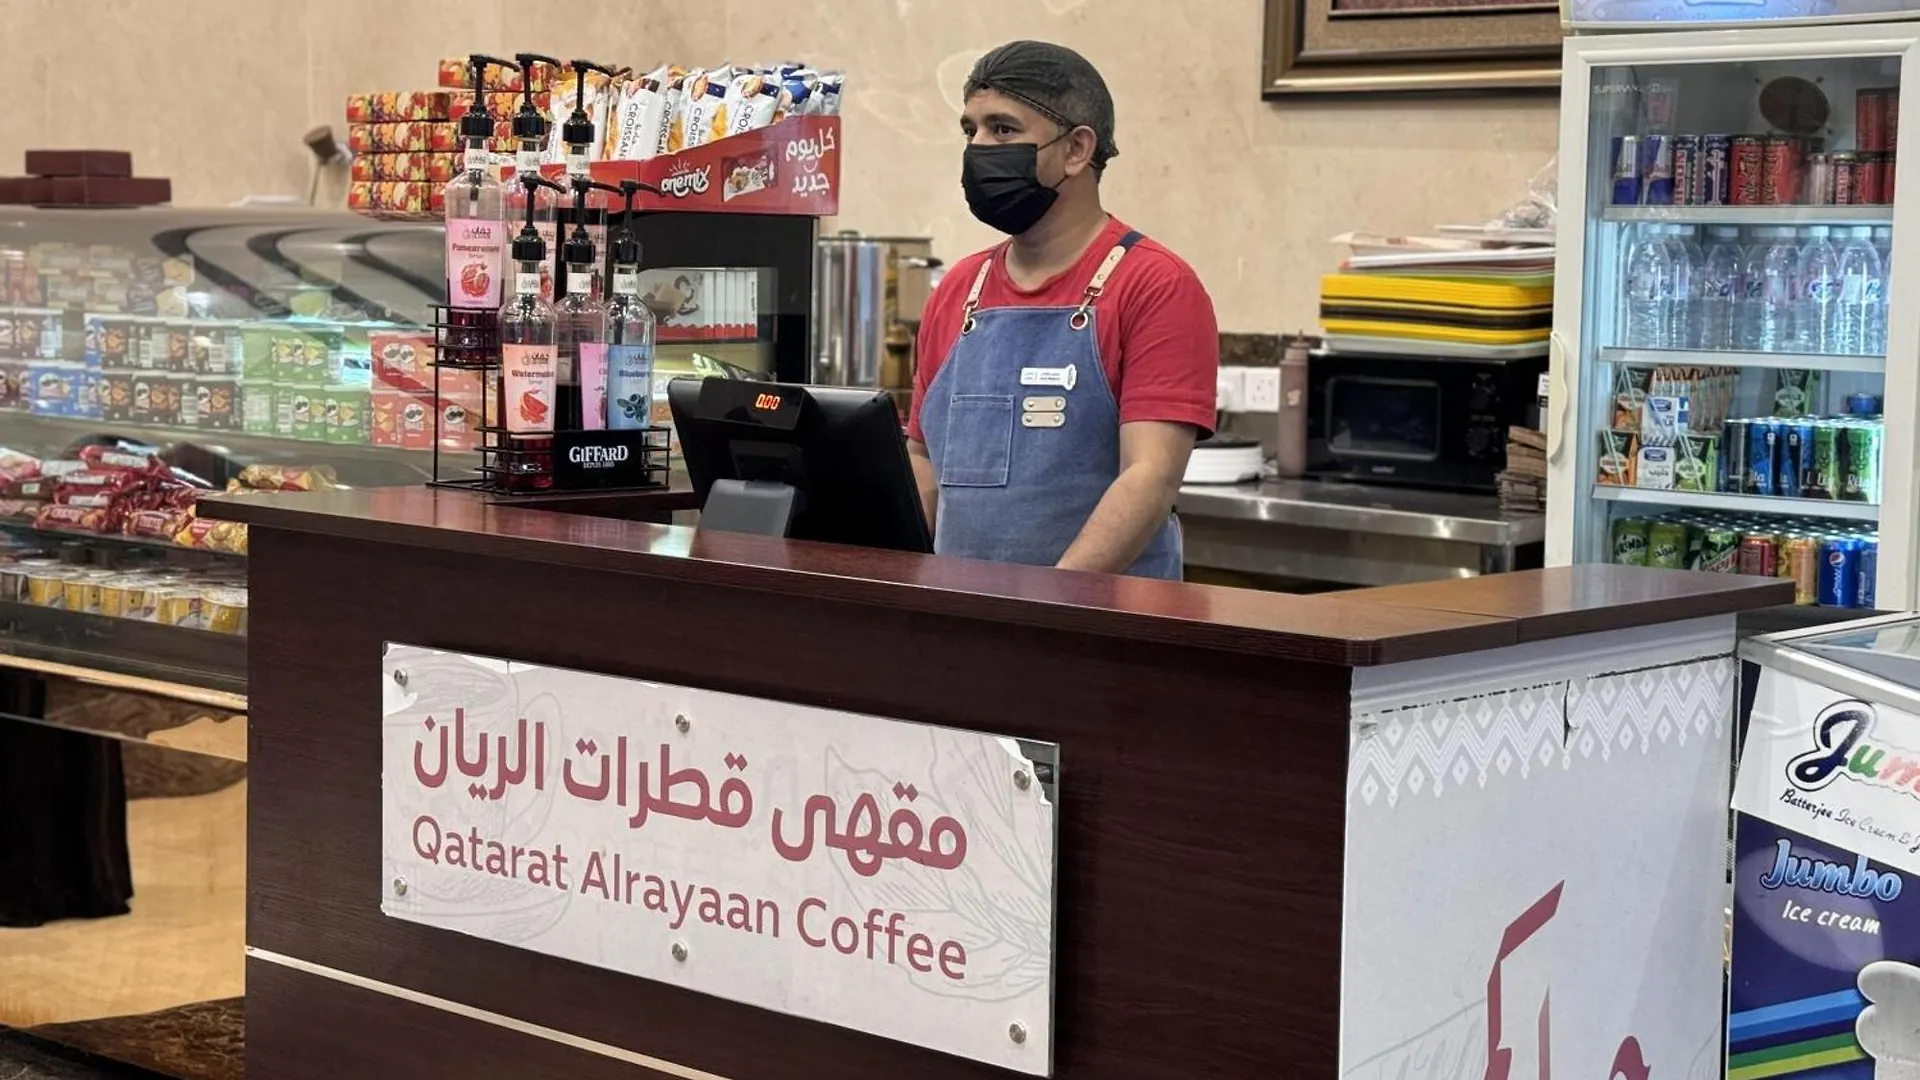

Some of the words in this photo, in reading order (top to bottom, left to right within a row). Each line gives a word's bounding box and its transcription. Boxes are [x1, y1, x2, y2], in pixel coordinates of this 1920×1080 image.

[791, 171, 831, 198] جديد
[569, 445, 629, 463] GIFFARD
[413, 707, 545, 800] الريان
[563, 736, 753, 829] قطرات
[771, 780, 967, 878] مقهى
[1780, 787, 1833, 820] Batterjee
[1834, 808, 1857, 828] Ice
[412, 815, 568, 890] Qatarat
[581, 851, 780, 937] Alrayaan
[796, 897, 967, 980] Coffee
[1761, 839, 1902, 900] Jumbo
[1782, 899, 1809, 923] Ice
[1817, 907, 1881, 936] cream
